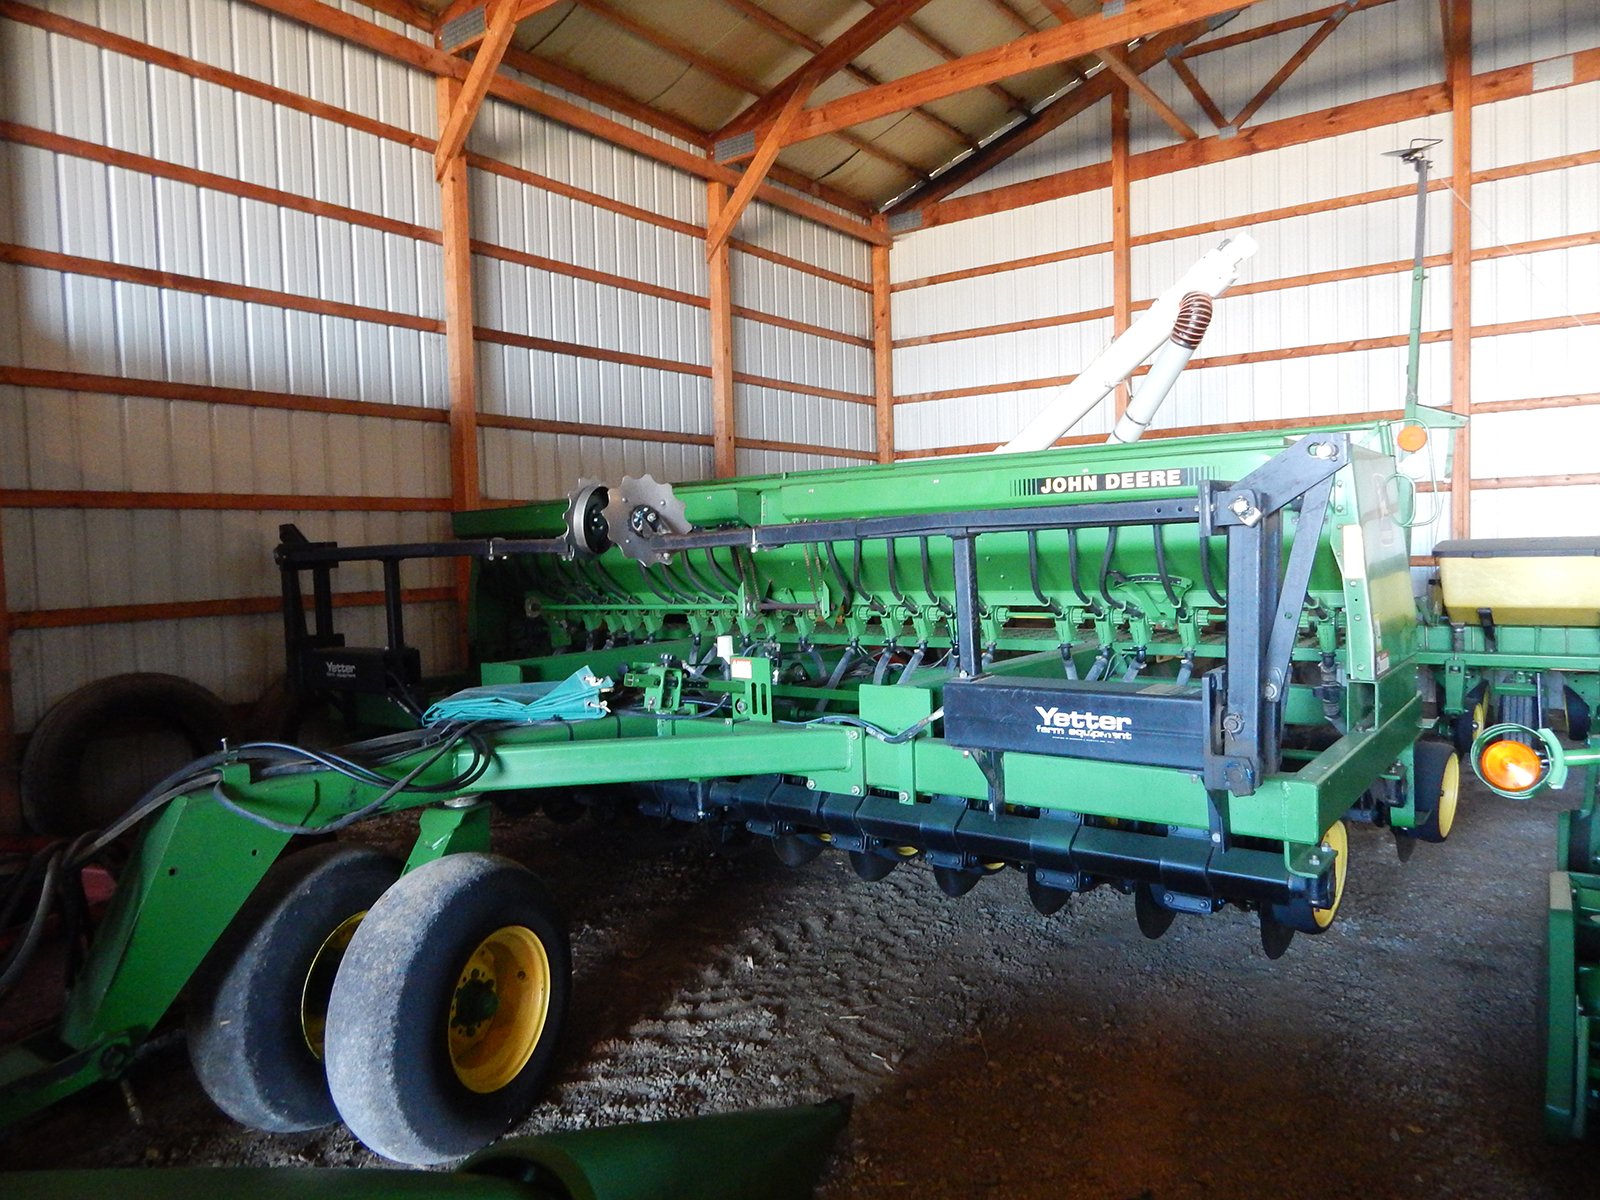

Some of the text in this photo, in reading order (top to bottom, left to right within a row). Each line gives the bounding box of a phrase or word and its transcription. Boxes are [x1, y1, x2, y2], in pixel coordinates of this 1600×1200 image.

[1040, 469, 1181, 494] JOHN DEERE
[325, 661, 356, 673] Yetter
[1035, 706, 1132, 731] Yetter
[1036, 725, 1064, 735] farm
